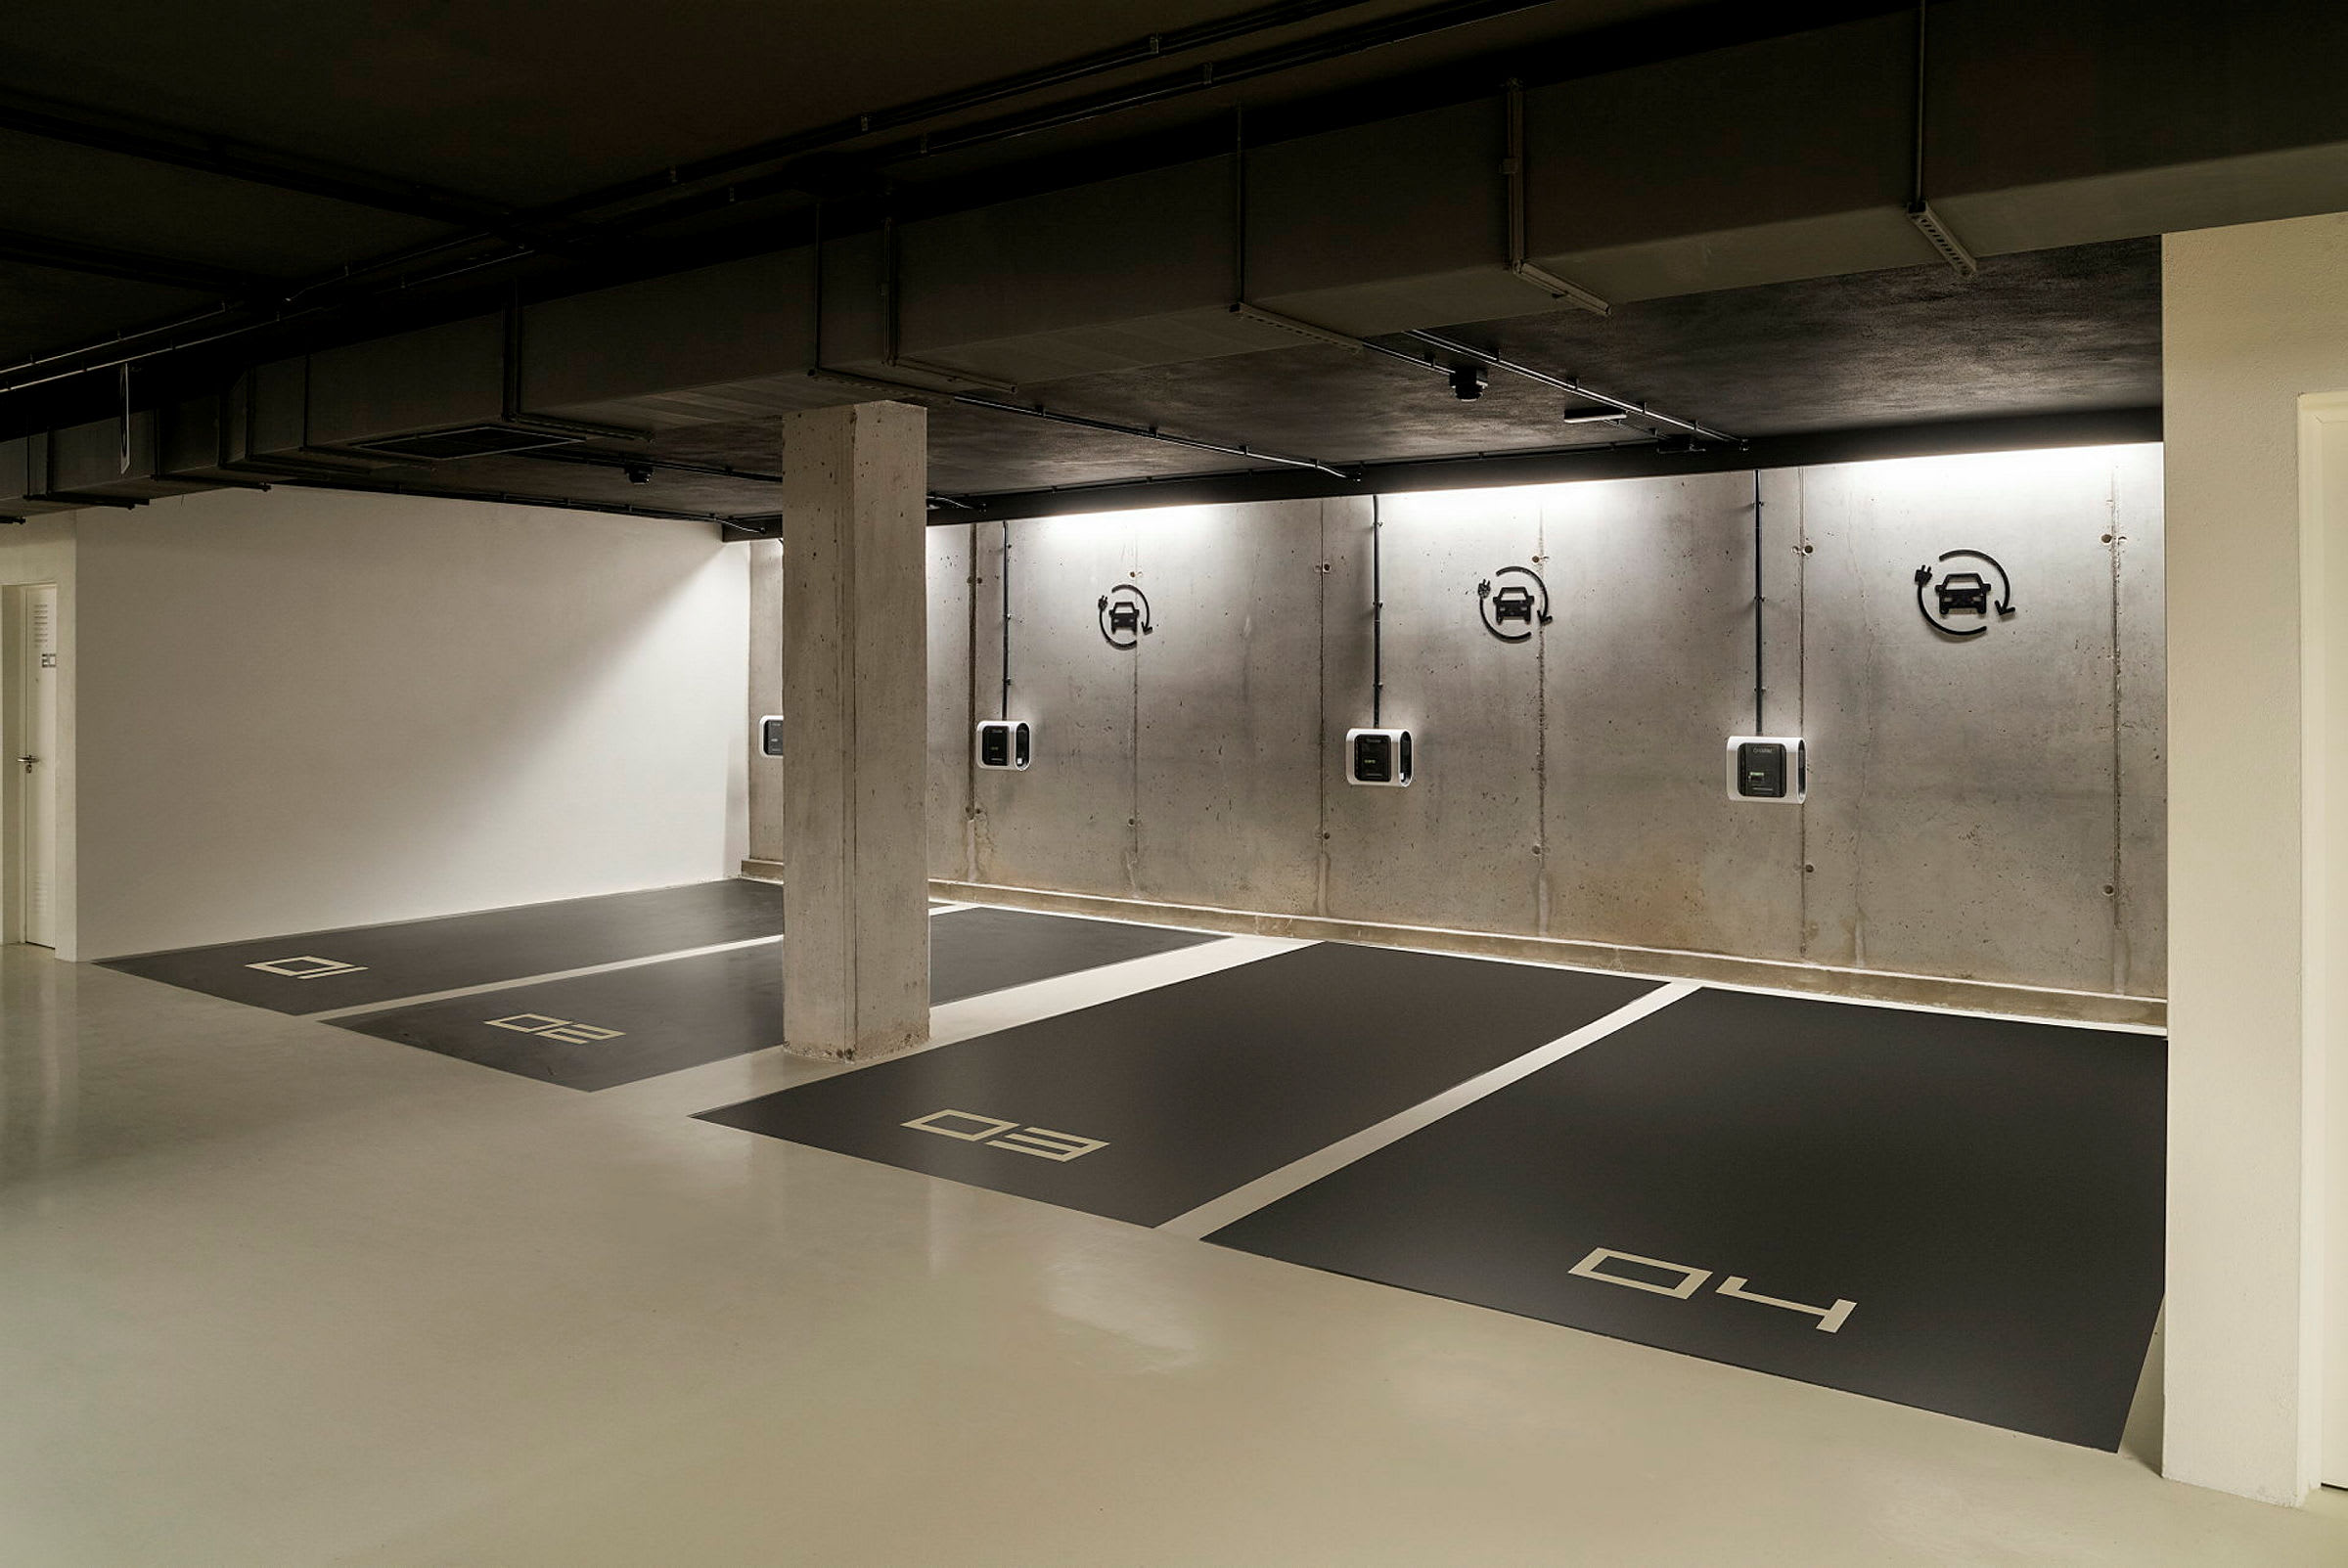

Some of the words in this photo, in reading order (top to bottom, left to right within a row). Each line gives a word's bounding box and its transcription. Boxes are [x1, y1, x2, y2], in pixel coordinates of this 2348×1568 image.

[245, 956, 369, 979] 01
[484, 1013, 627, 1045] 02
[900, 1109, 1111, 1163] 03
[1567, 1247, 1858, 1333] 04
